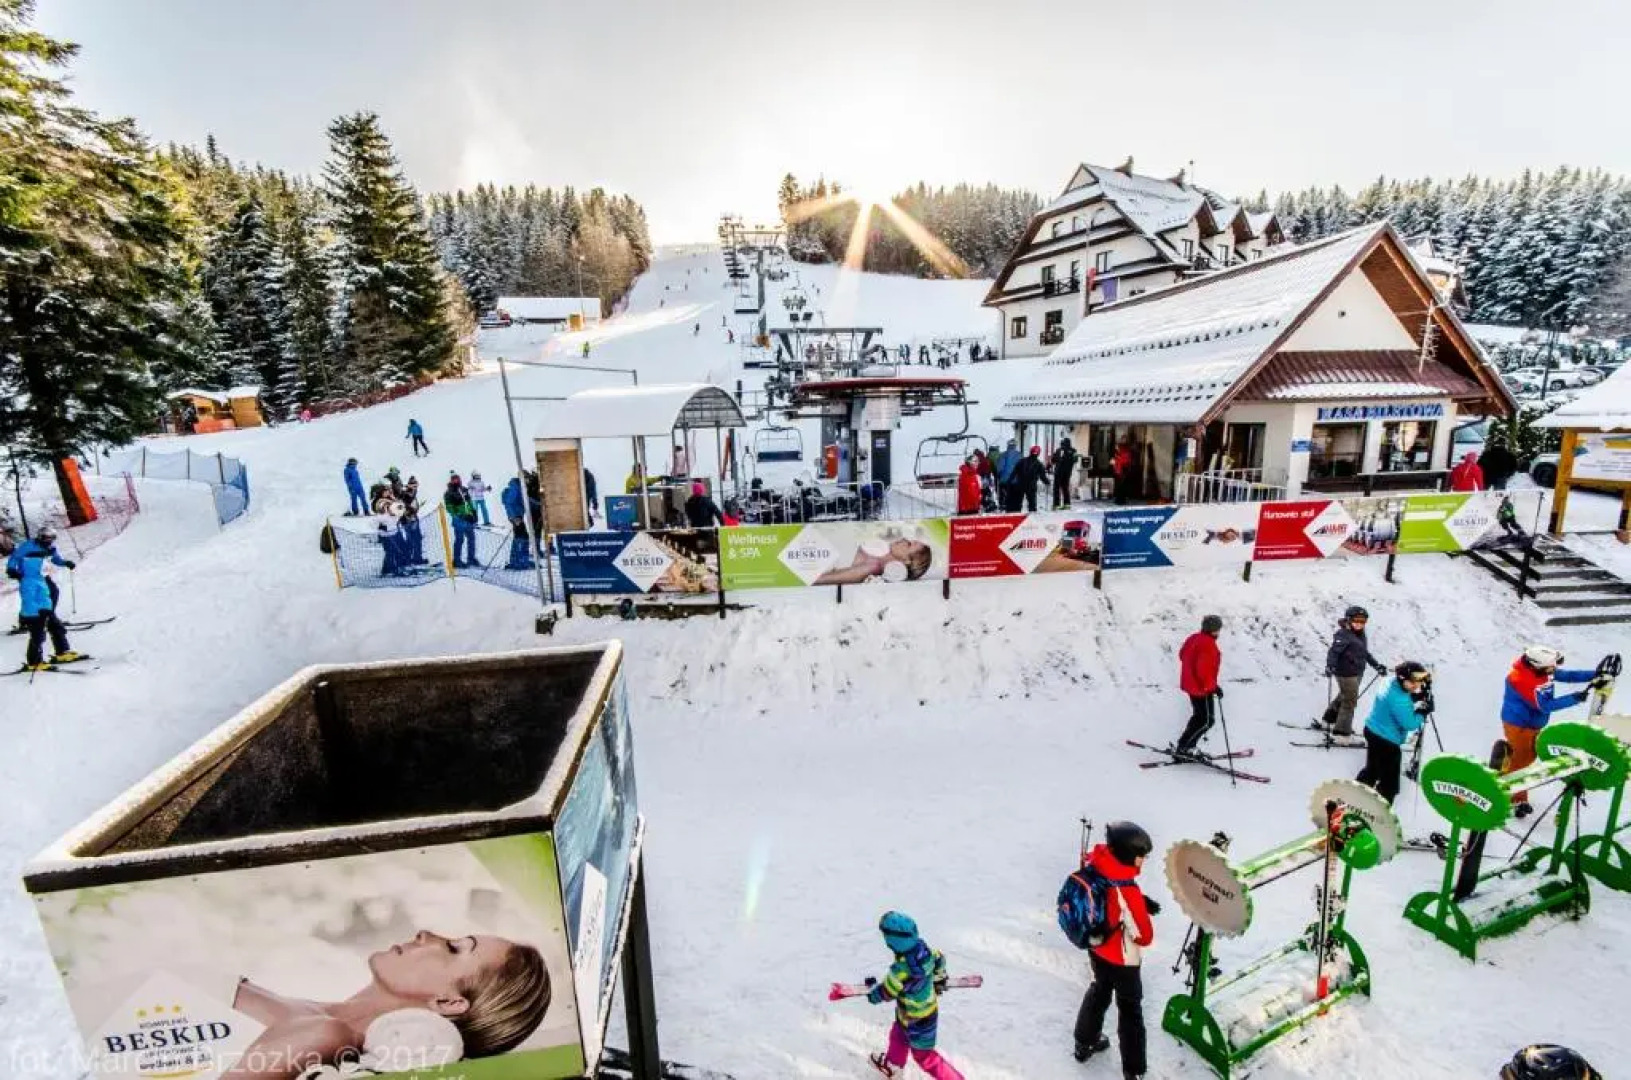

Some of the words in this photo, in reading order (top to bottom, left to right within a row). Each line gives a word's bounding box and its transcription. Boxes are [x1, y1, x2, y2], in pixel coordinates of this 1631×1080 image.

[728, 533, 778, 545] Wellness
[1160, 529, 1199, 541] BESKID
[728, 547, 737, 559] &
[740, 547, 761, 559] SPA
[787, 549, 830, 560] BESKID
[622, 554, 664, 567] BESKID
[1435, 781, 1488, 809] TYMBARK
[103, 1021, 232, 1054] BESKID
